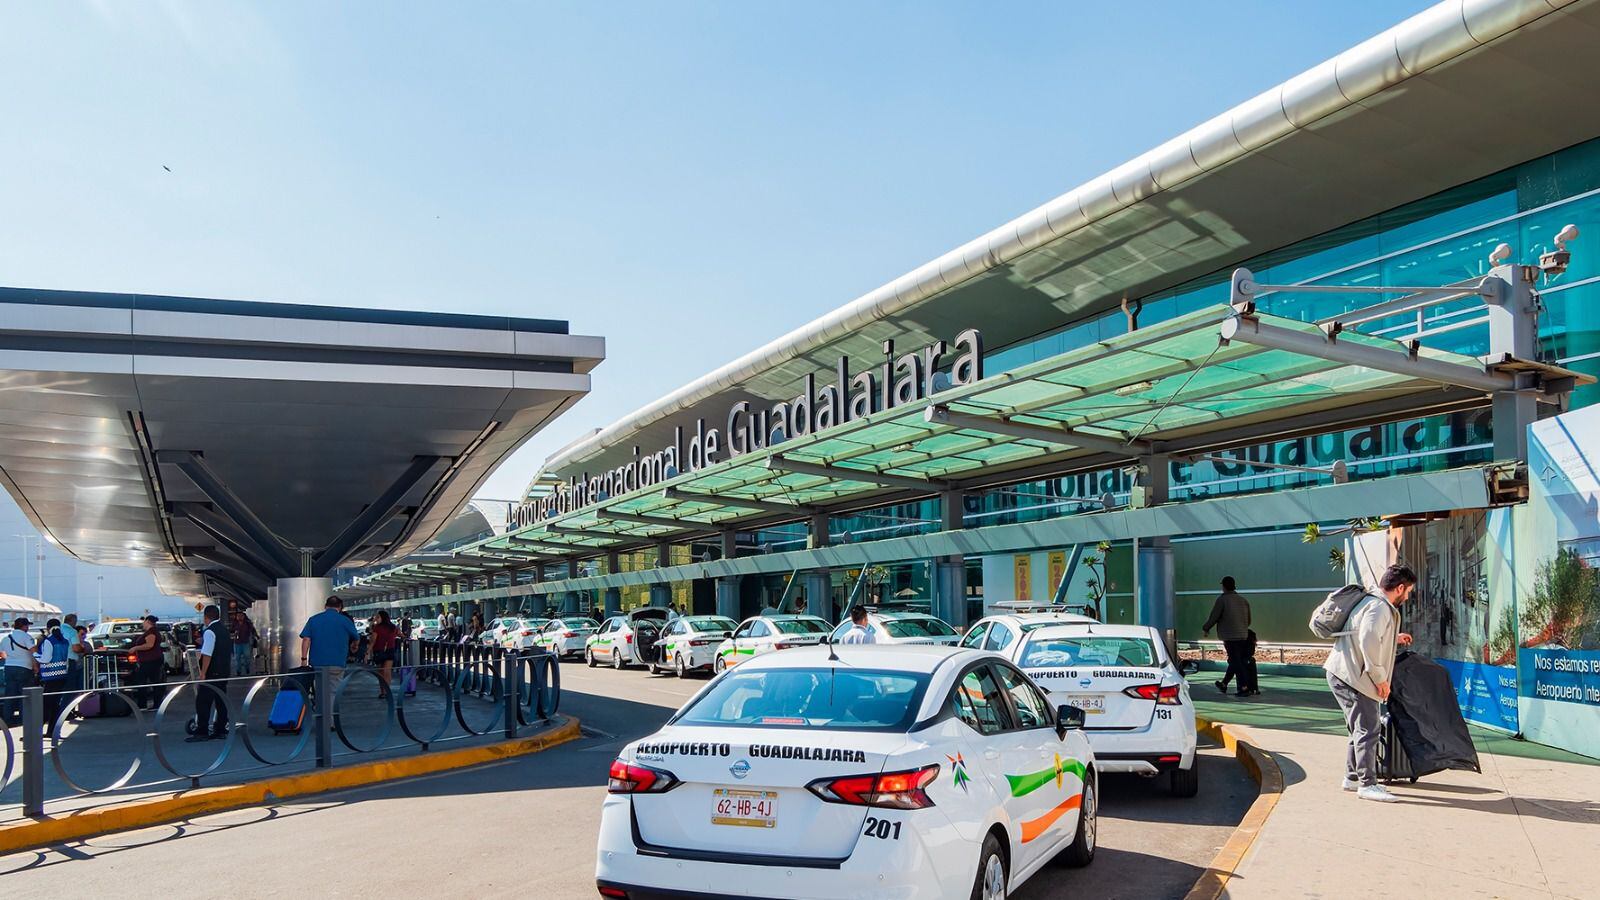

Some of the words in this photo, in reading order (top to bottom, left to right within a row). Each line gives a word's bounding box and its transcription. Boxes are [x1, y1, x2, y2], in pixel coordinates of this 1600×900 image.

[569, 426, 684, 512] Internacional
[688, 418, 721, 471] de
[727, 328, 984, 458] Guadalajara
[1534, 653, 1552, 670] Nos
[1554, 655, 1589, 673] estamos
[1590, 659, 1600, 673] re
[1027, 670, 1078, 680] ROPUERTO
[1092, 670, 1156, 680] GUADALAJARA
[1536, 680, 1583, 701] Aeropuerto
[1156, 709, 1172, 720] 131
[636, 742, 731, 758] AEROPUERTO
[748, 743, 866, 763] GUADALAJARA
[717, 799, 772, 817] 62-HB-4J
[863, 816, 902, 841] 201
